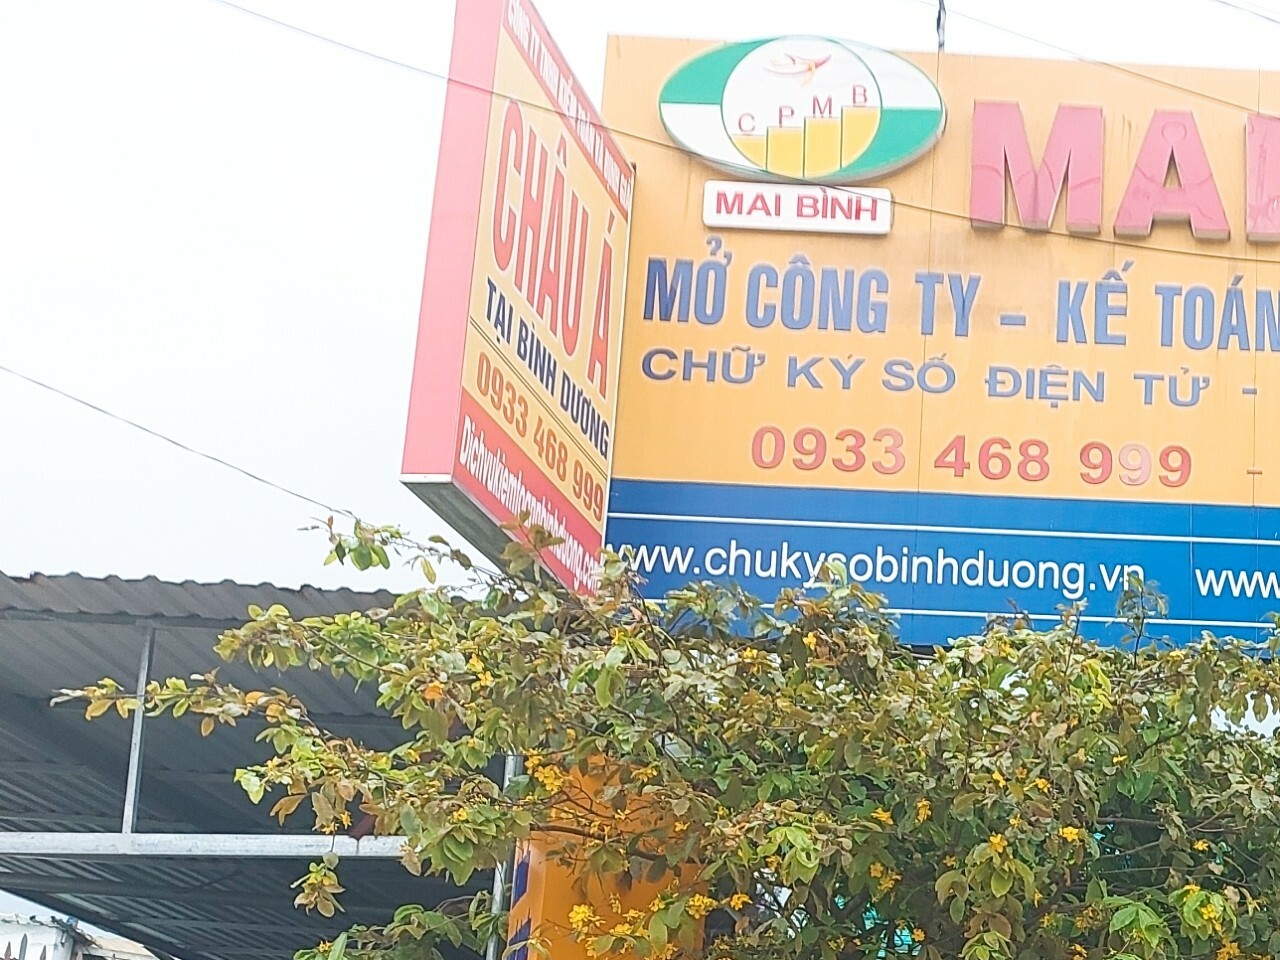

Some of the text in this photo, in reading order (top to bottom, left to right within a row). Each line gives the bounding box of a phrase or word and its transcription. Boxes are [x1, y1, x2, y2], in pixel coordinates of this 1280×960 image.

[492, 101, 616, 400] CHÂU Á
[716, 187, 878, 221] MAI BÌNH
[644, 236, 732, 324] MỞ
[744, 254, 890, 333] CÔNG
[914, 272, 981, 338] TY
[1057, 260, 1134, 345] KẾ
[485, 276, 611, 460] TẠI BÌNH DƯƠNG
[641, 346, 766, 384] CHỮ
[788, 357, 867, 390] KÝ
[882, 353, 957, 393] SỐ
[985, 365, 1105, 408] ĐIỆN
[1134, 367, 1211, 407] TỬ
[477, 351, 605, 522] 0933 468 999
[751, 425, 906, 475] 0933
[934, 434, 1050, 481] 468
[1079, 441, 1192, 487] 999
